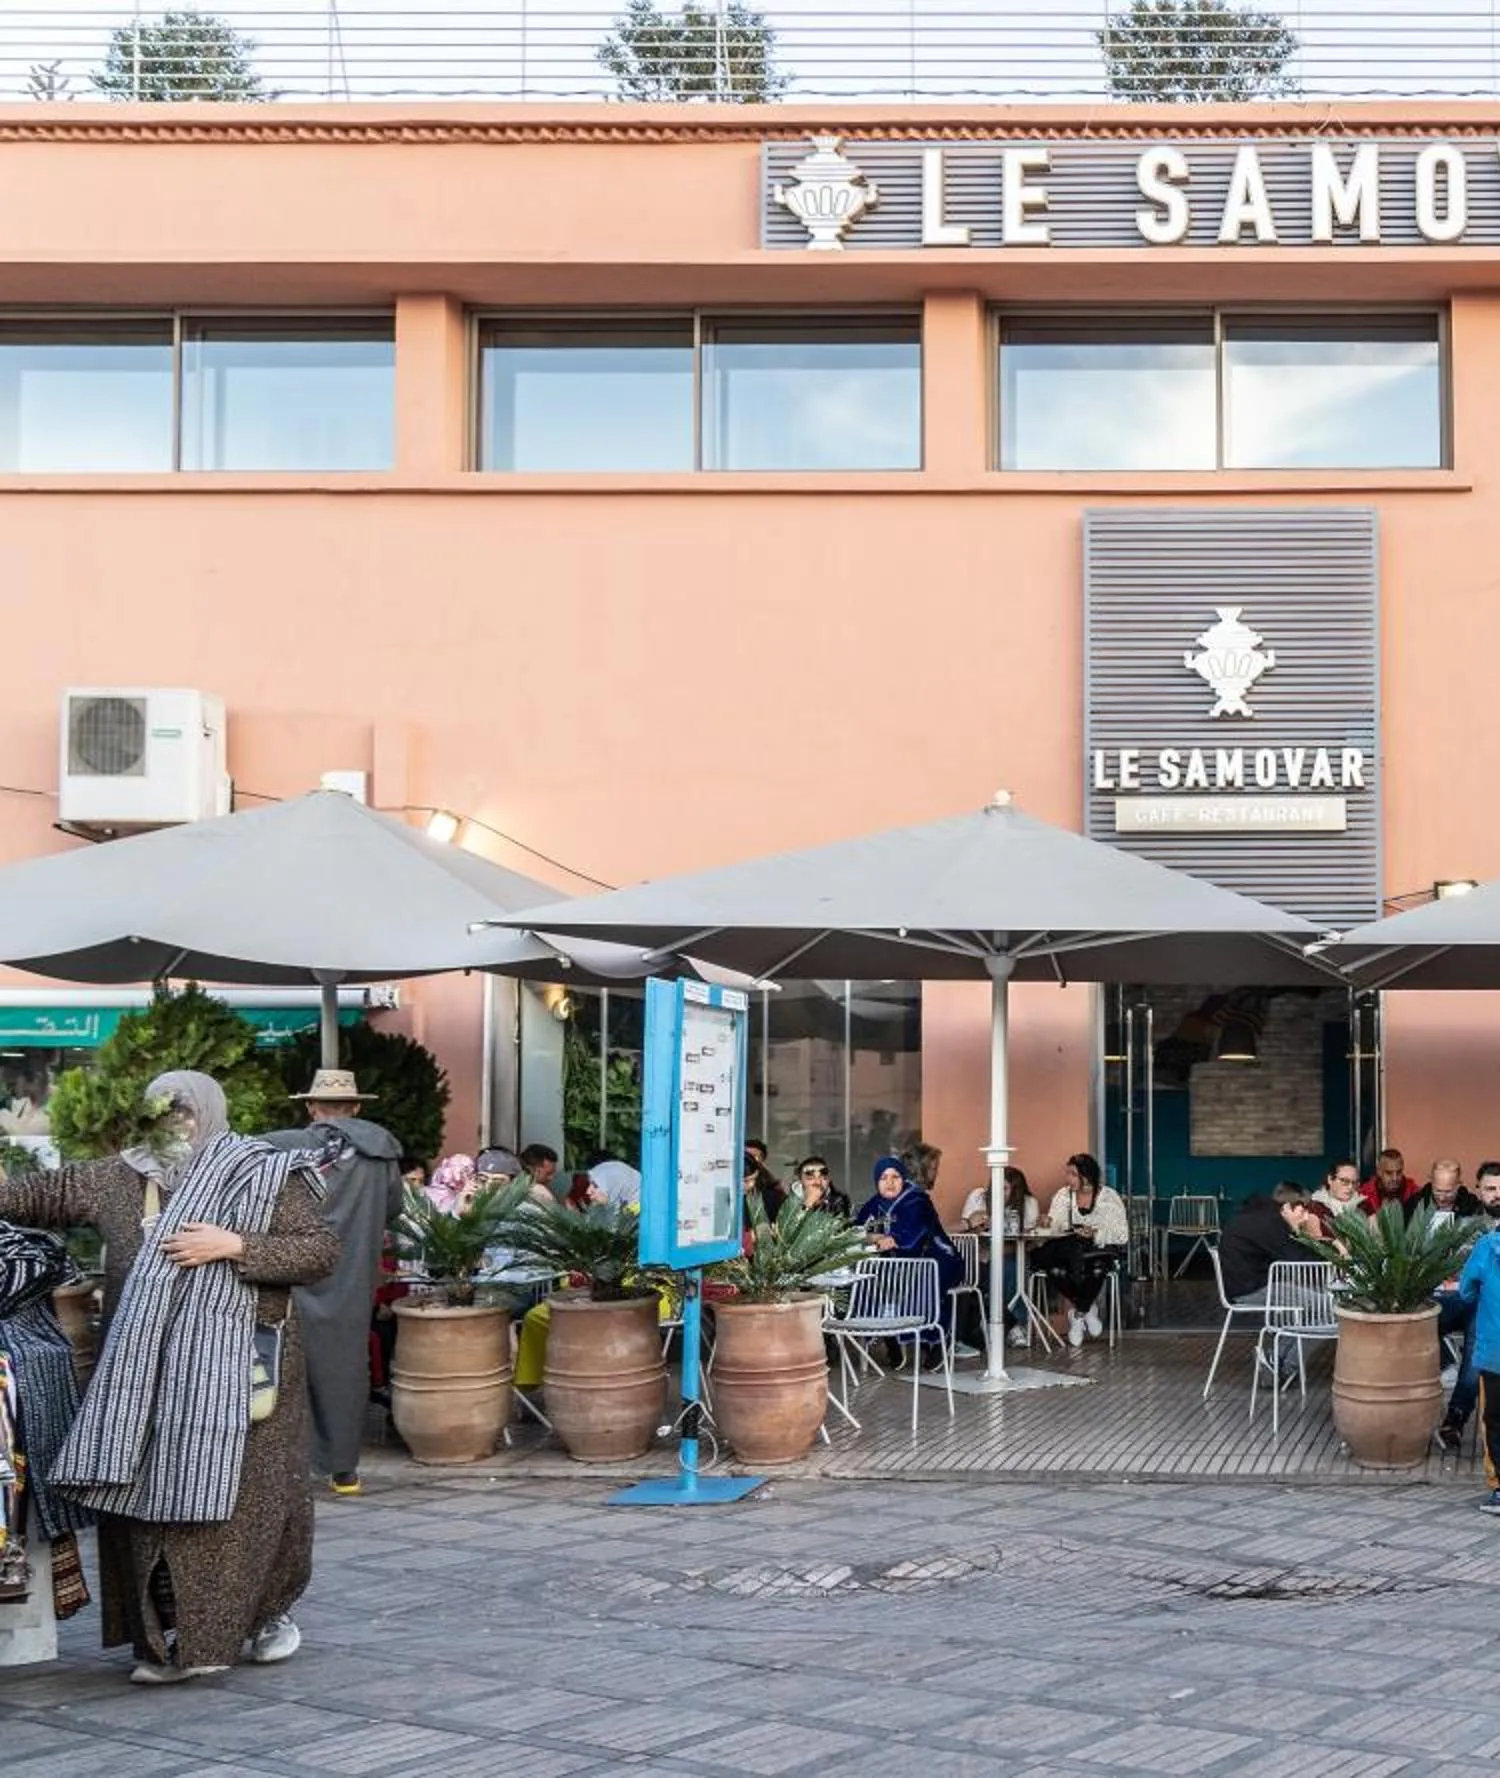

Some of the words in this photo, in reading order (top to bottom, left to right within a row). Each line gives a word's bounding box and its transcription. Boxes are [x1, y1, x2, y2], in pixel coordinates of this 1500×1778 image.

[922, 147, 1053, 247] LE
[1094, 749, 1141, 789] LE
[1158, 747, 1366, 789] SAMOVAR
